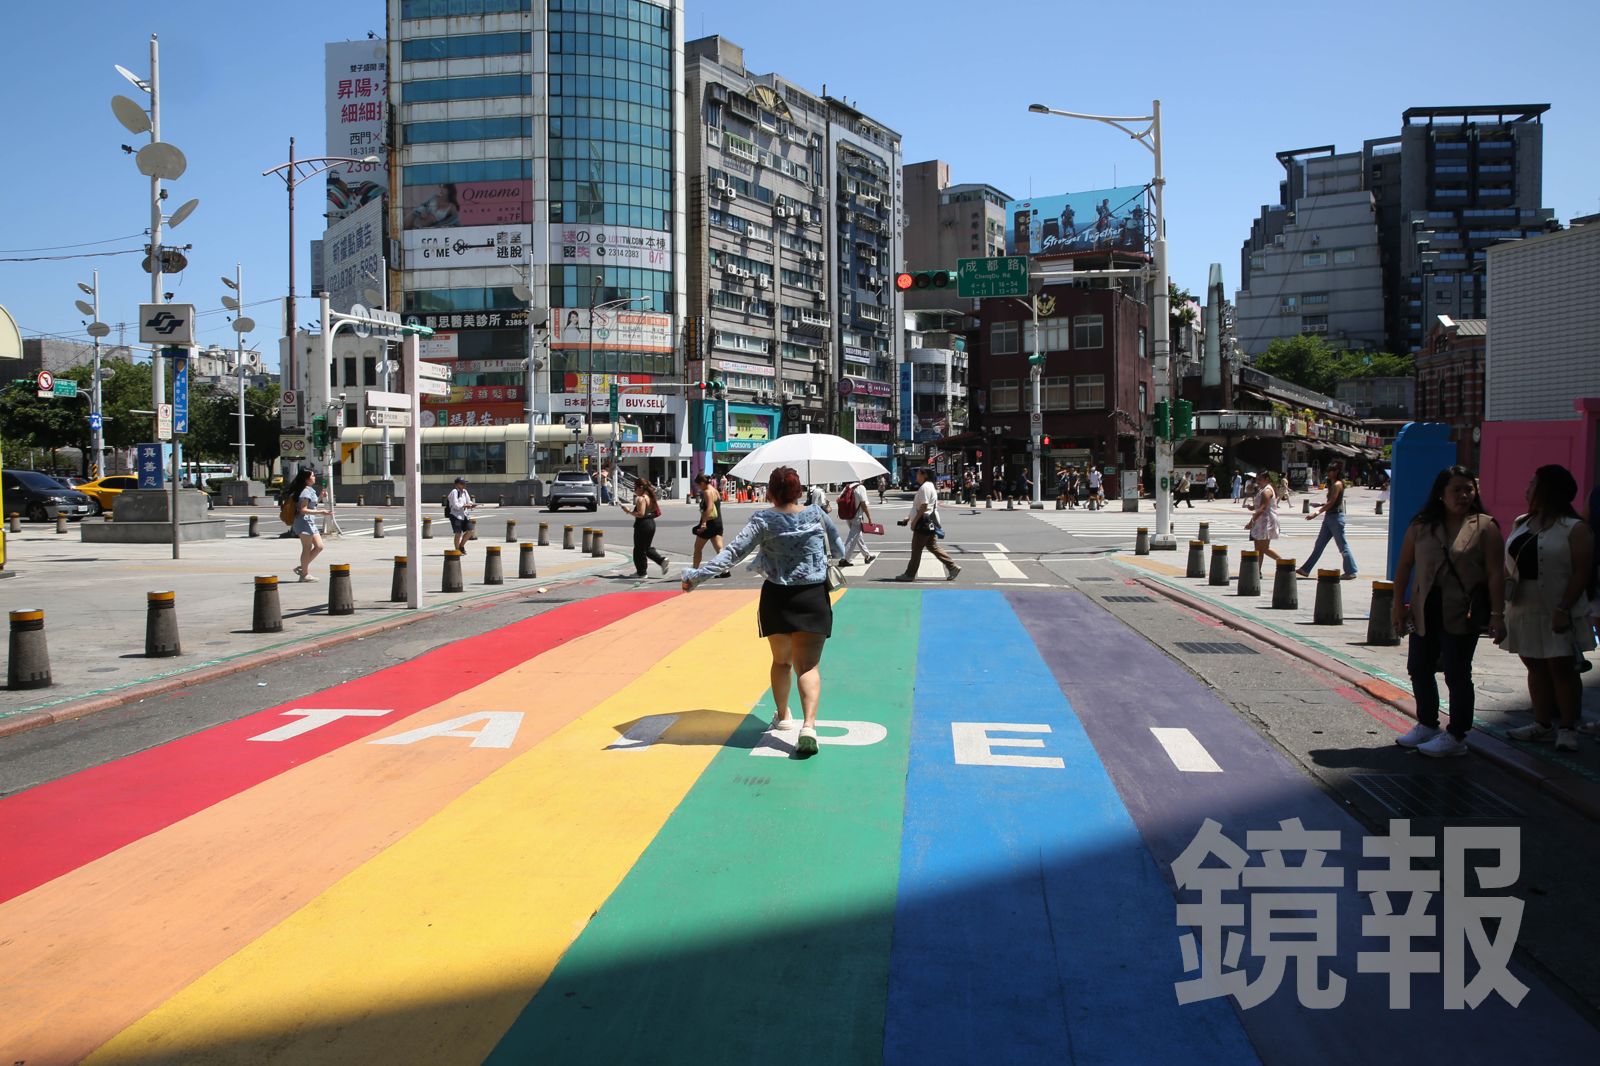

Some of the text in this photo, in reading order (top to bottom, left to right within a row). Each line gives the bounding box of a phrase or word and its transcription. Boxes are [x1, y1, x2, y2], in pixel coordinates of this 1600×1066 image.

[423, 248, 450, 258] GME
[497, 246, 523, 259] 逃脫
[965, 259, 1019, 272] 成都路
[621, 446, 655, 454] STREET
